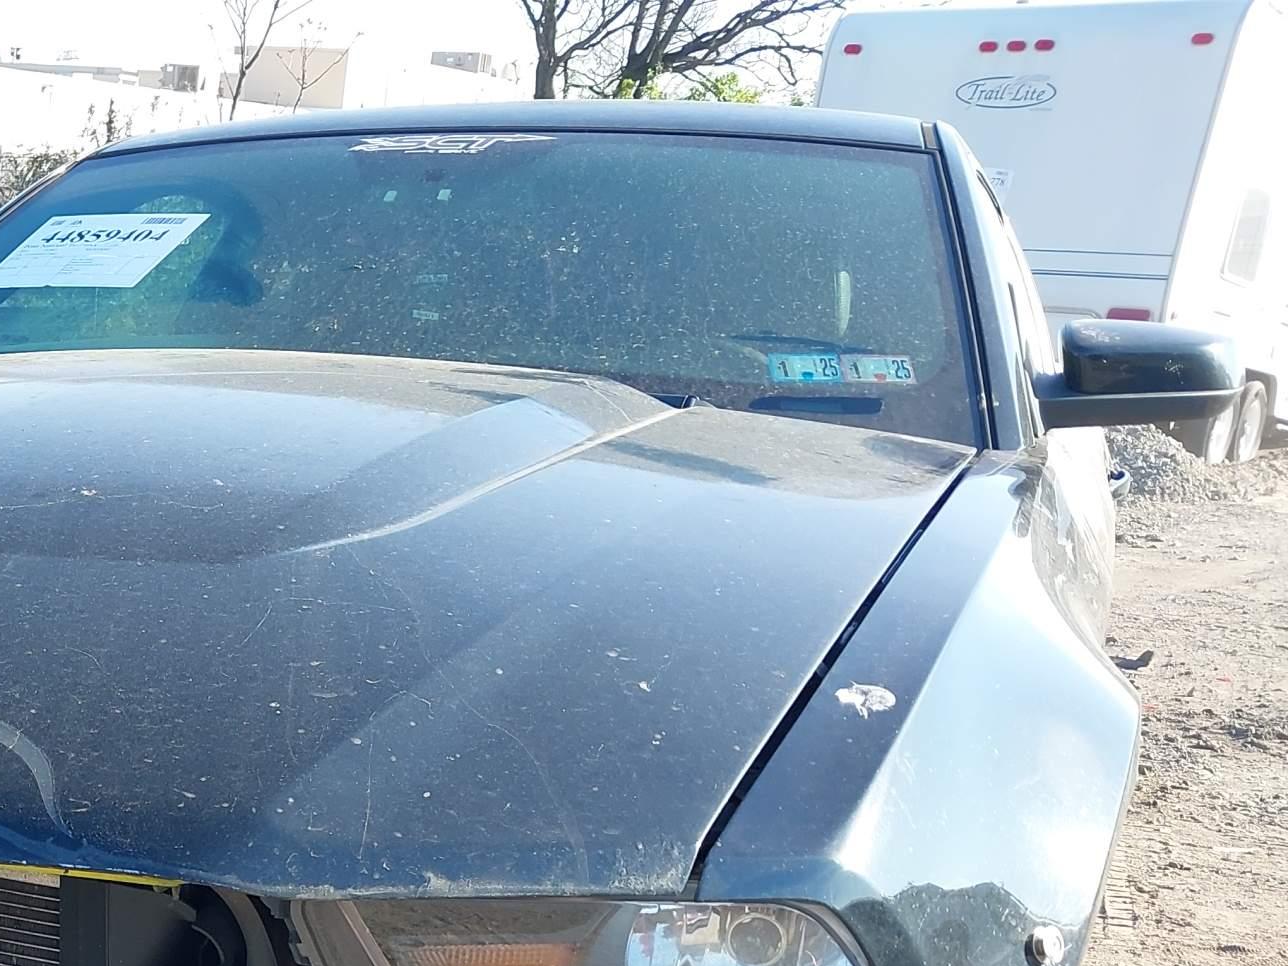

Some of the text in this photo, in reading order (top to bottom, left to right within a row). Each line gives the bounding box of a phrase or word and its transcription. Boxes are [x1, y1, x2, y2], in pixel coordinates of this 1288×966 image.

[967, 83, 1047, 103] Trail-Lite
[41, 229, 170, 243] 44859404
[778, 358, 838, 377] 1 25
[850, 359, 911, 379] 1 25
